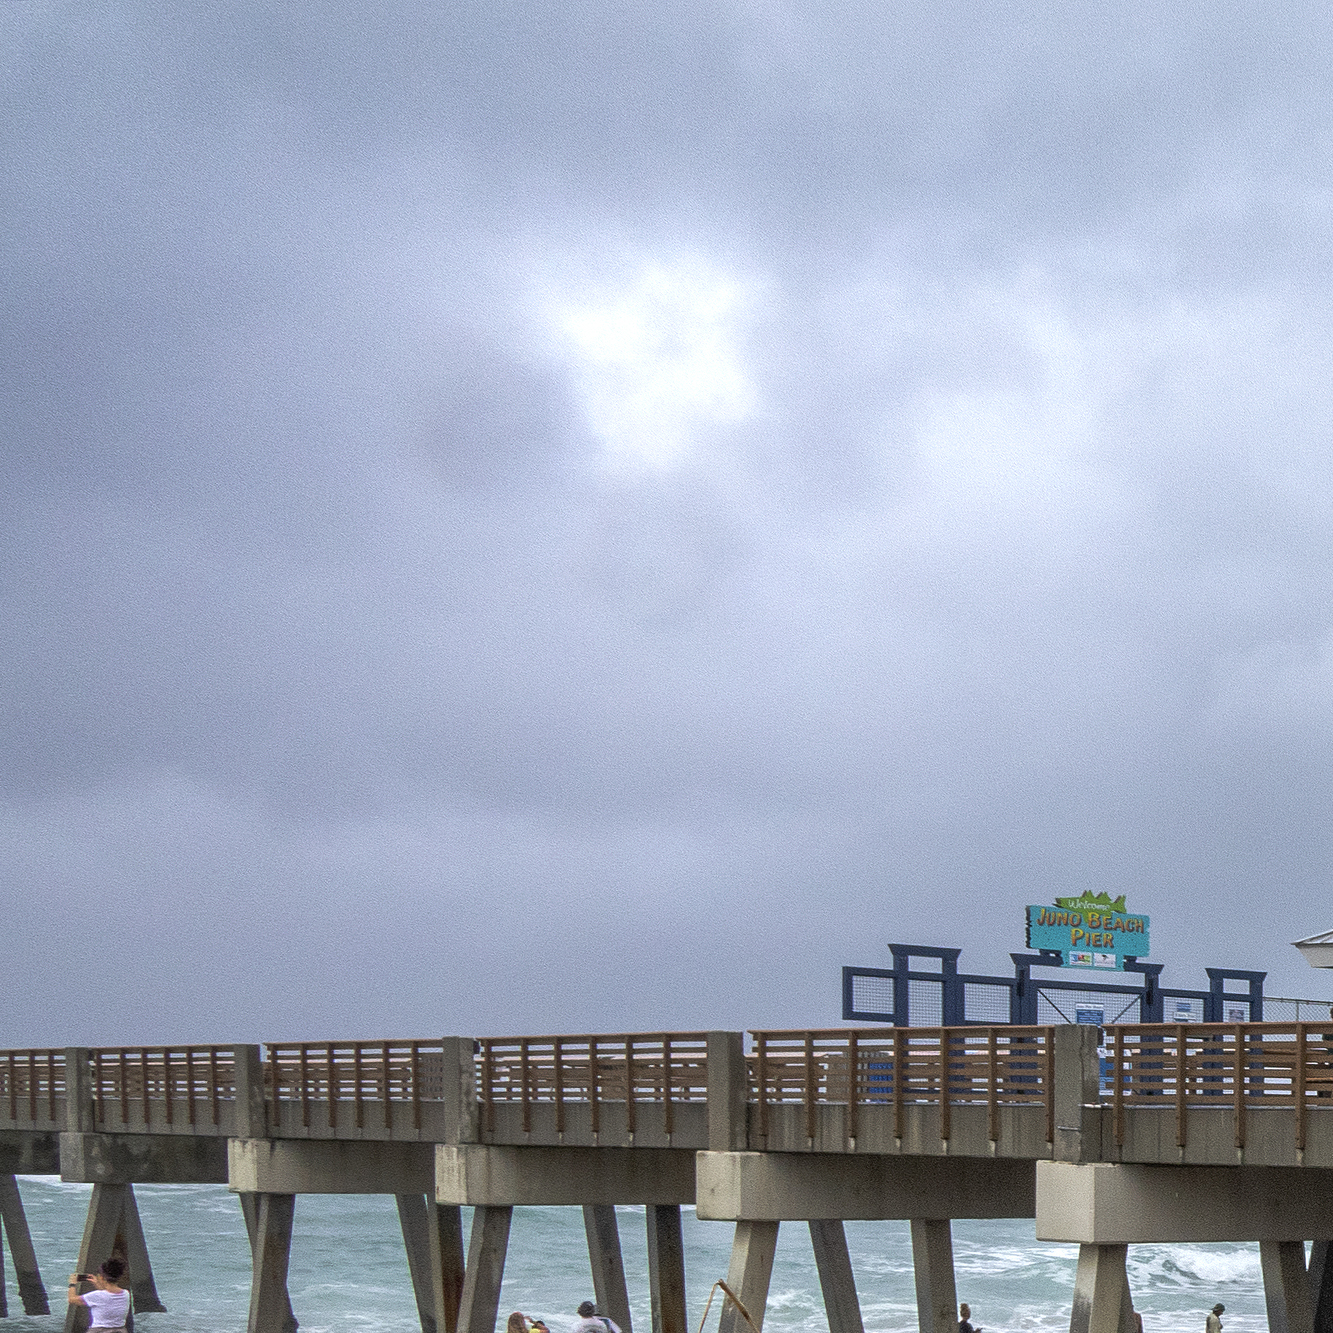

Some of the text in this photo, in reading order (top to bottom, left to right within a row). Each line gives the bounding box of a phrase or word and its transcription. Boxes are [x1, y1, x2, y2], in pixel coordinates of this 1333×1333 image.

[1037, 908, 1145, 934] JUNO BEACH
[1071, 928, 1114, 948] PIER
